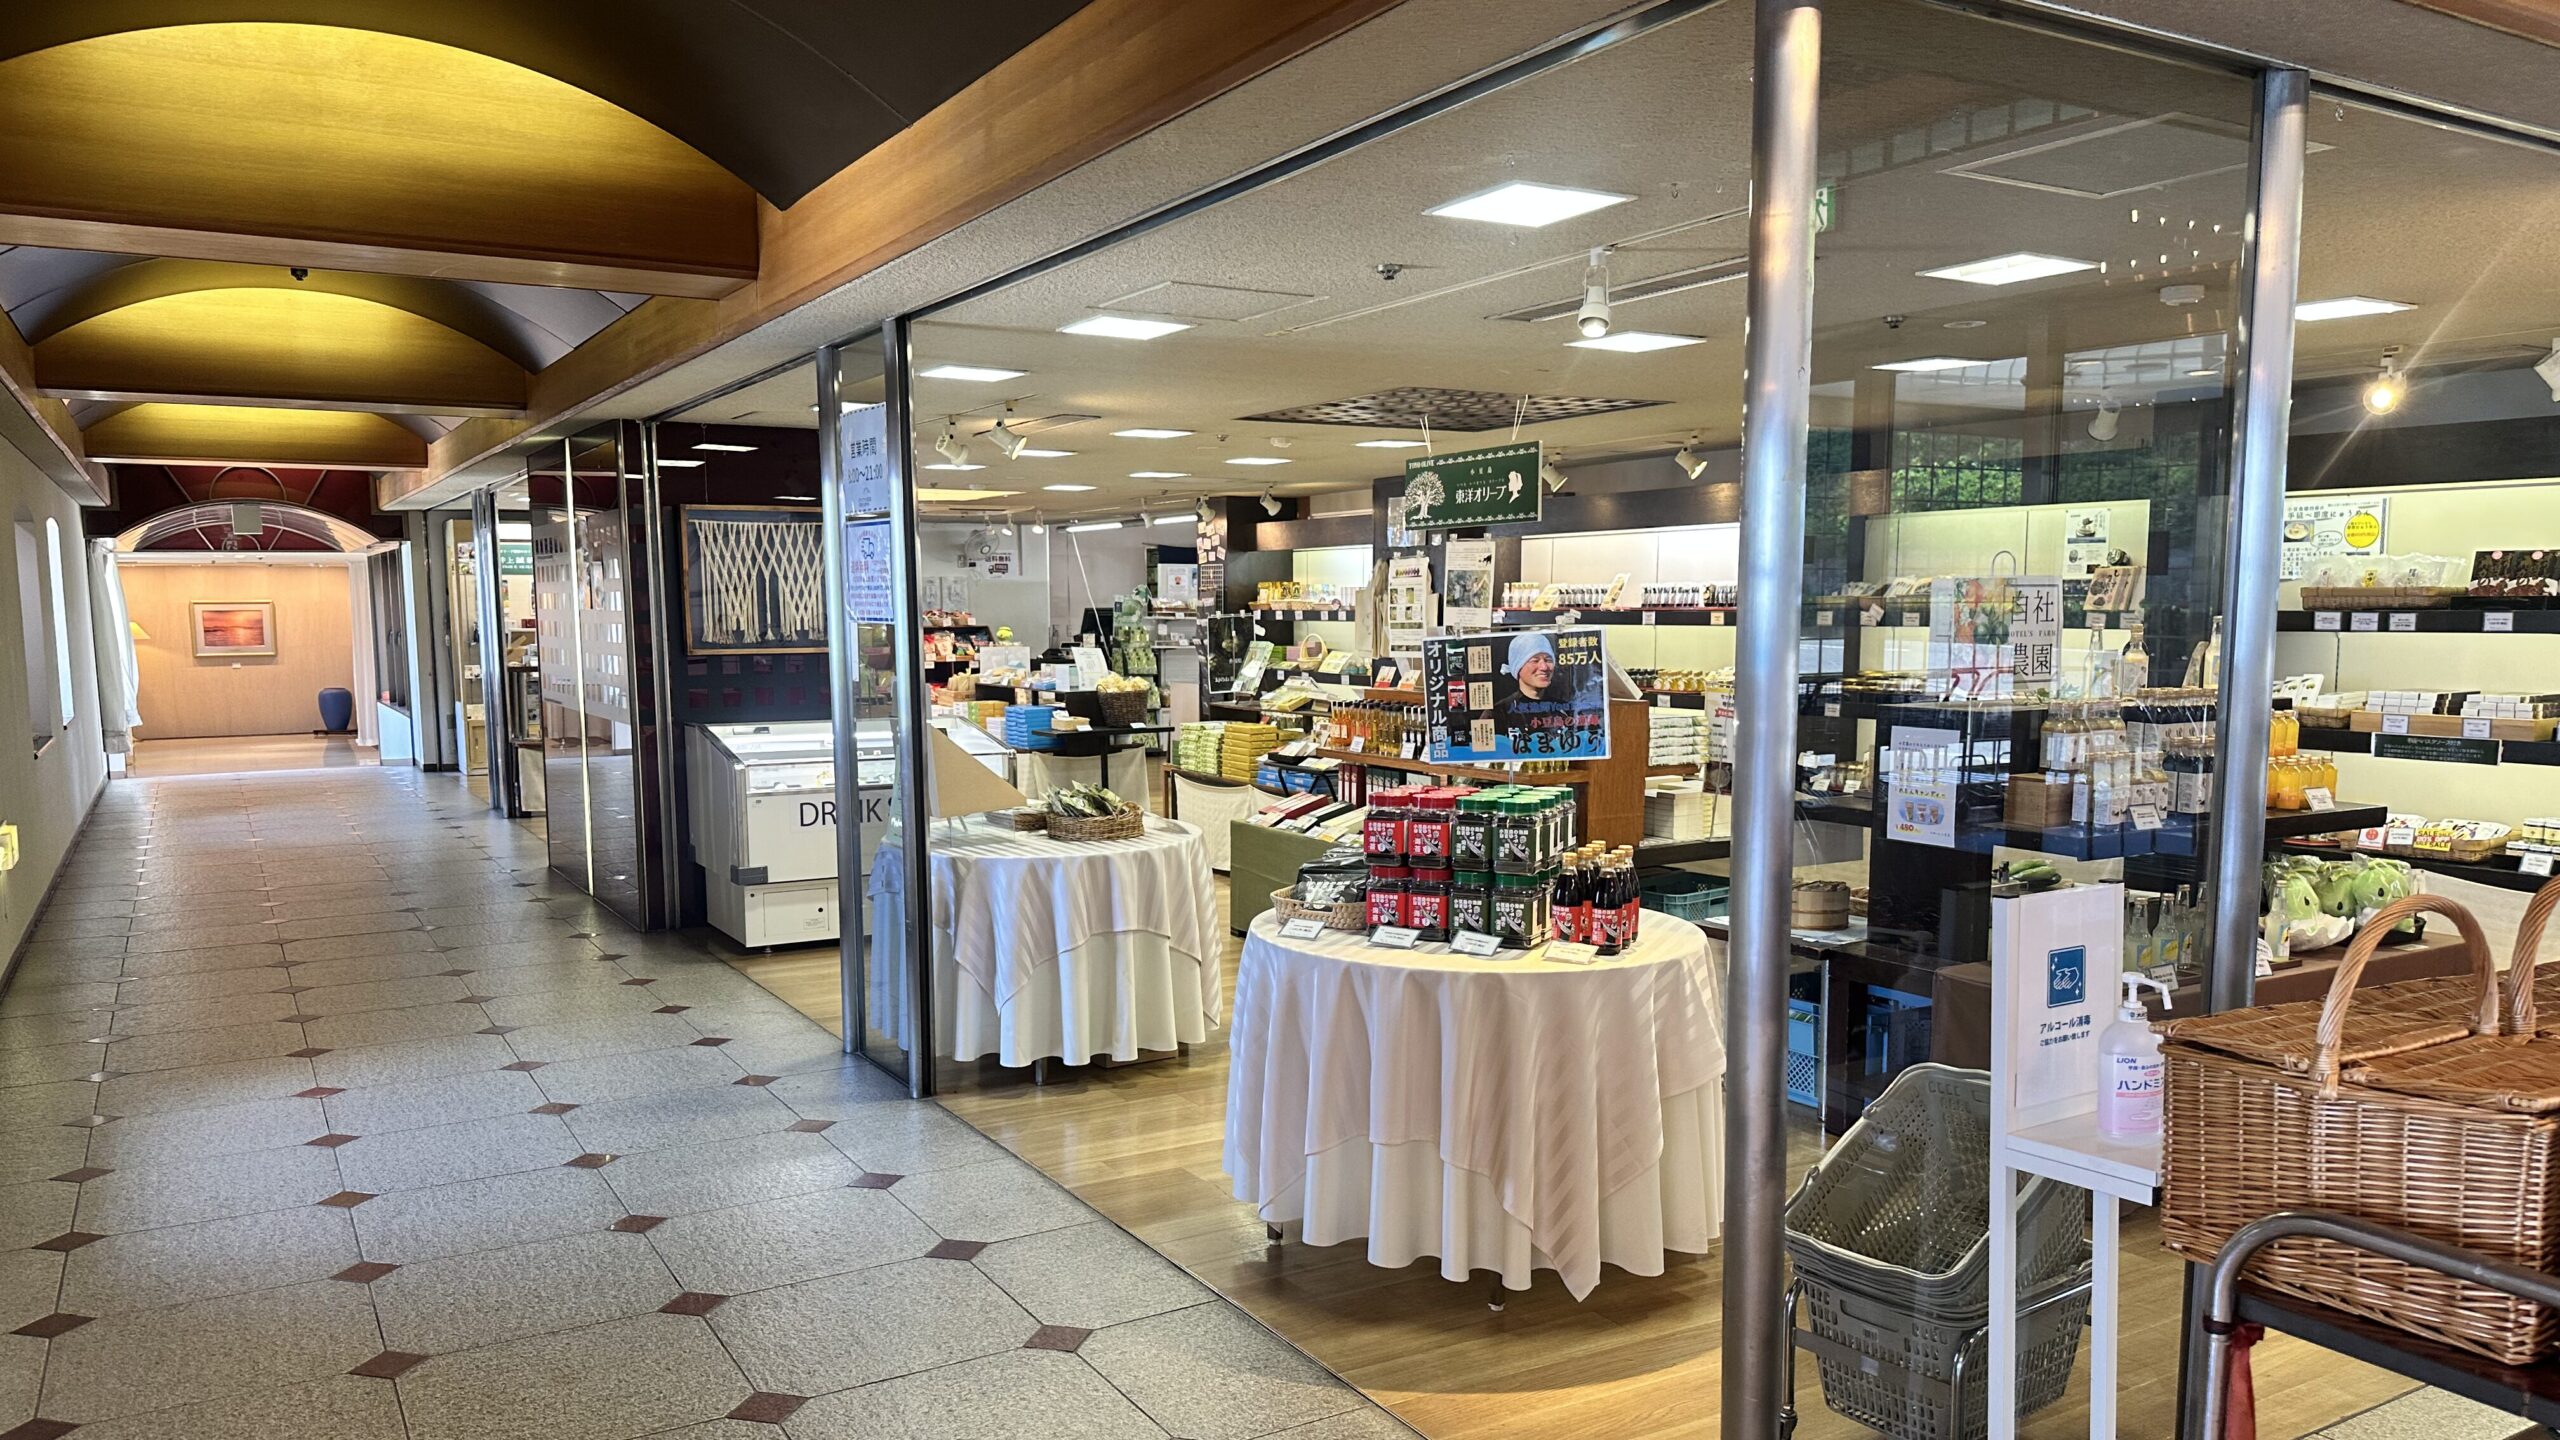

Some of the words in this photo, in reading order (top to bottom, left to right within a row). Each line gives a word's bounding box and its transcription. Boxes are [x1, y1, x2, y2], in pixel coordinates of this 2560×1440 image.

[850, 437, 877, 458] 営業時間
[2011, 590, 2055, 624] 自社
[1558, 636, 1599, 648] 登録者数
[1558, 651, 1602, 666] 85万人
[2013, 643, 2053, 676] 農園
[1427, 641, 1449, 759] オリジナル商品
[2040, 1014, 2091, 1034] アルコール消毒
